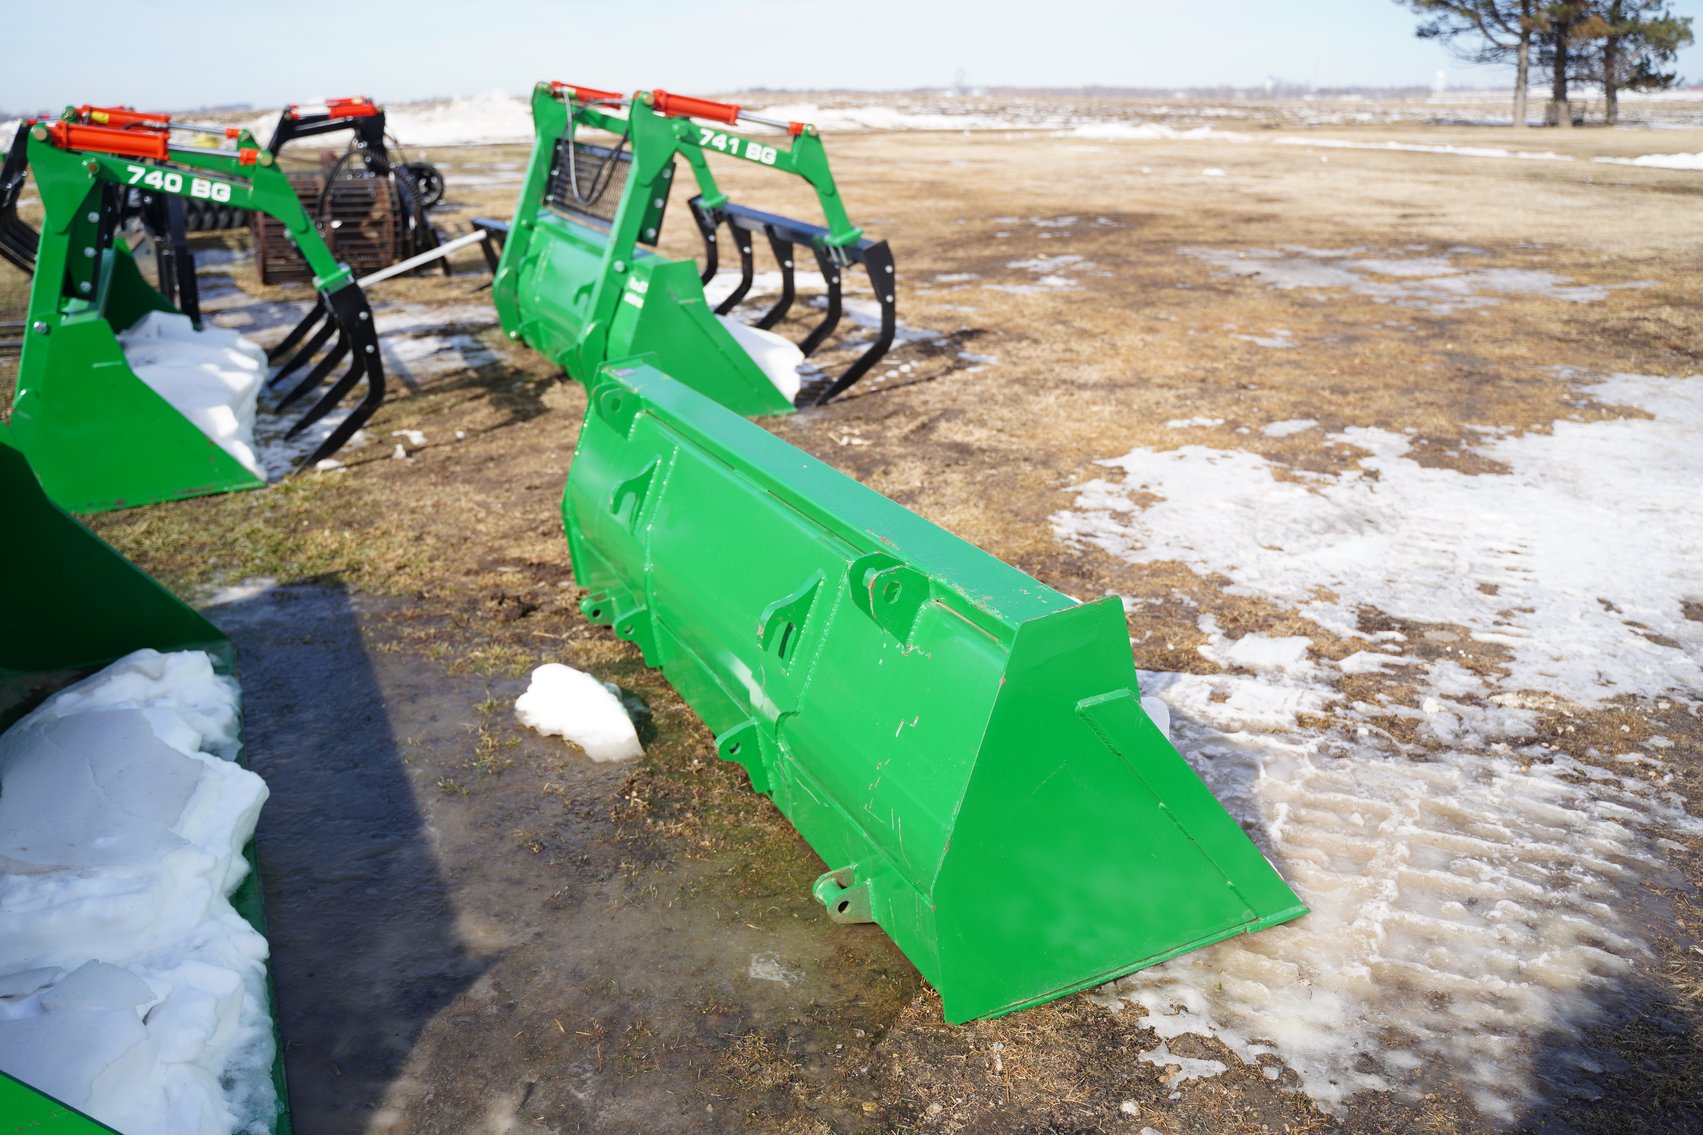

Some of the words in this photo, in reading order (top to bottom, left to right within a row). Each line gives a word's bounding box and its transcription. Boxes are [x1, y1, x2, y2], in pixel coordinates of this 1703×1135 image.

[699, 128, 740, 155] 741
[745, 142, 777, 165] BG
[126, 164, 183, 193] 740
[191, 177, 232, 203] BG
